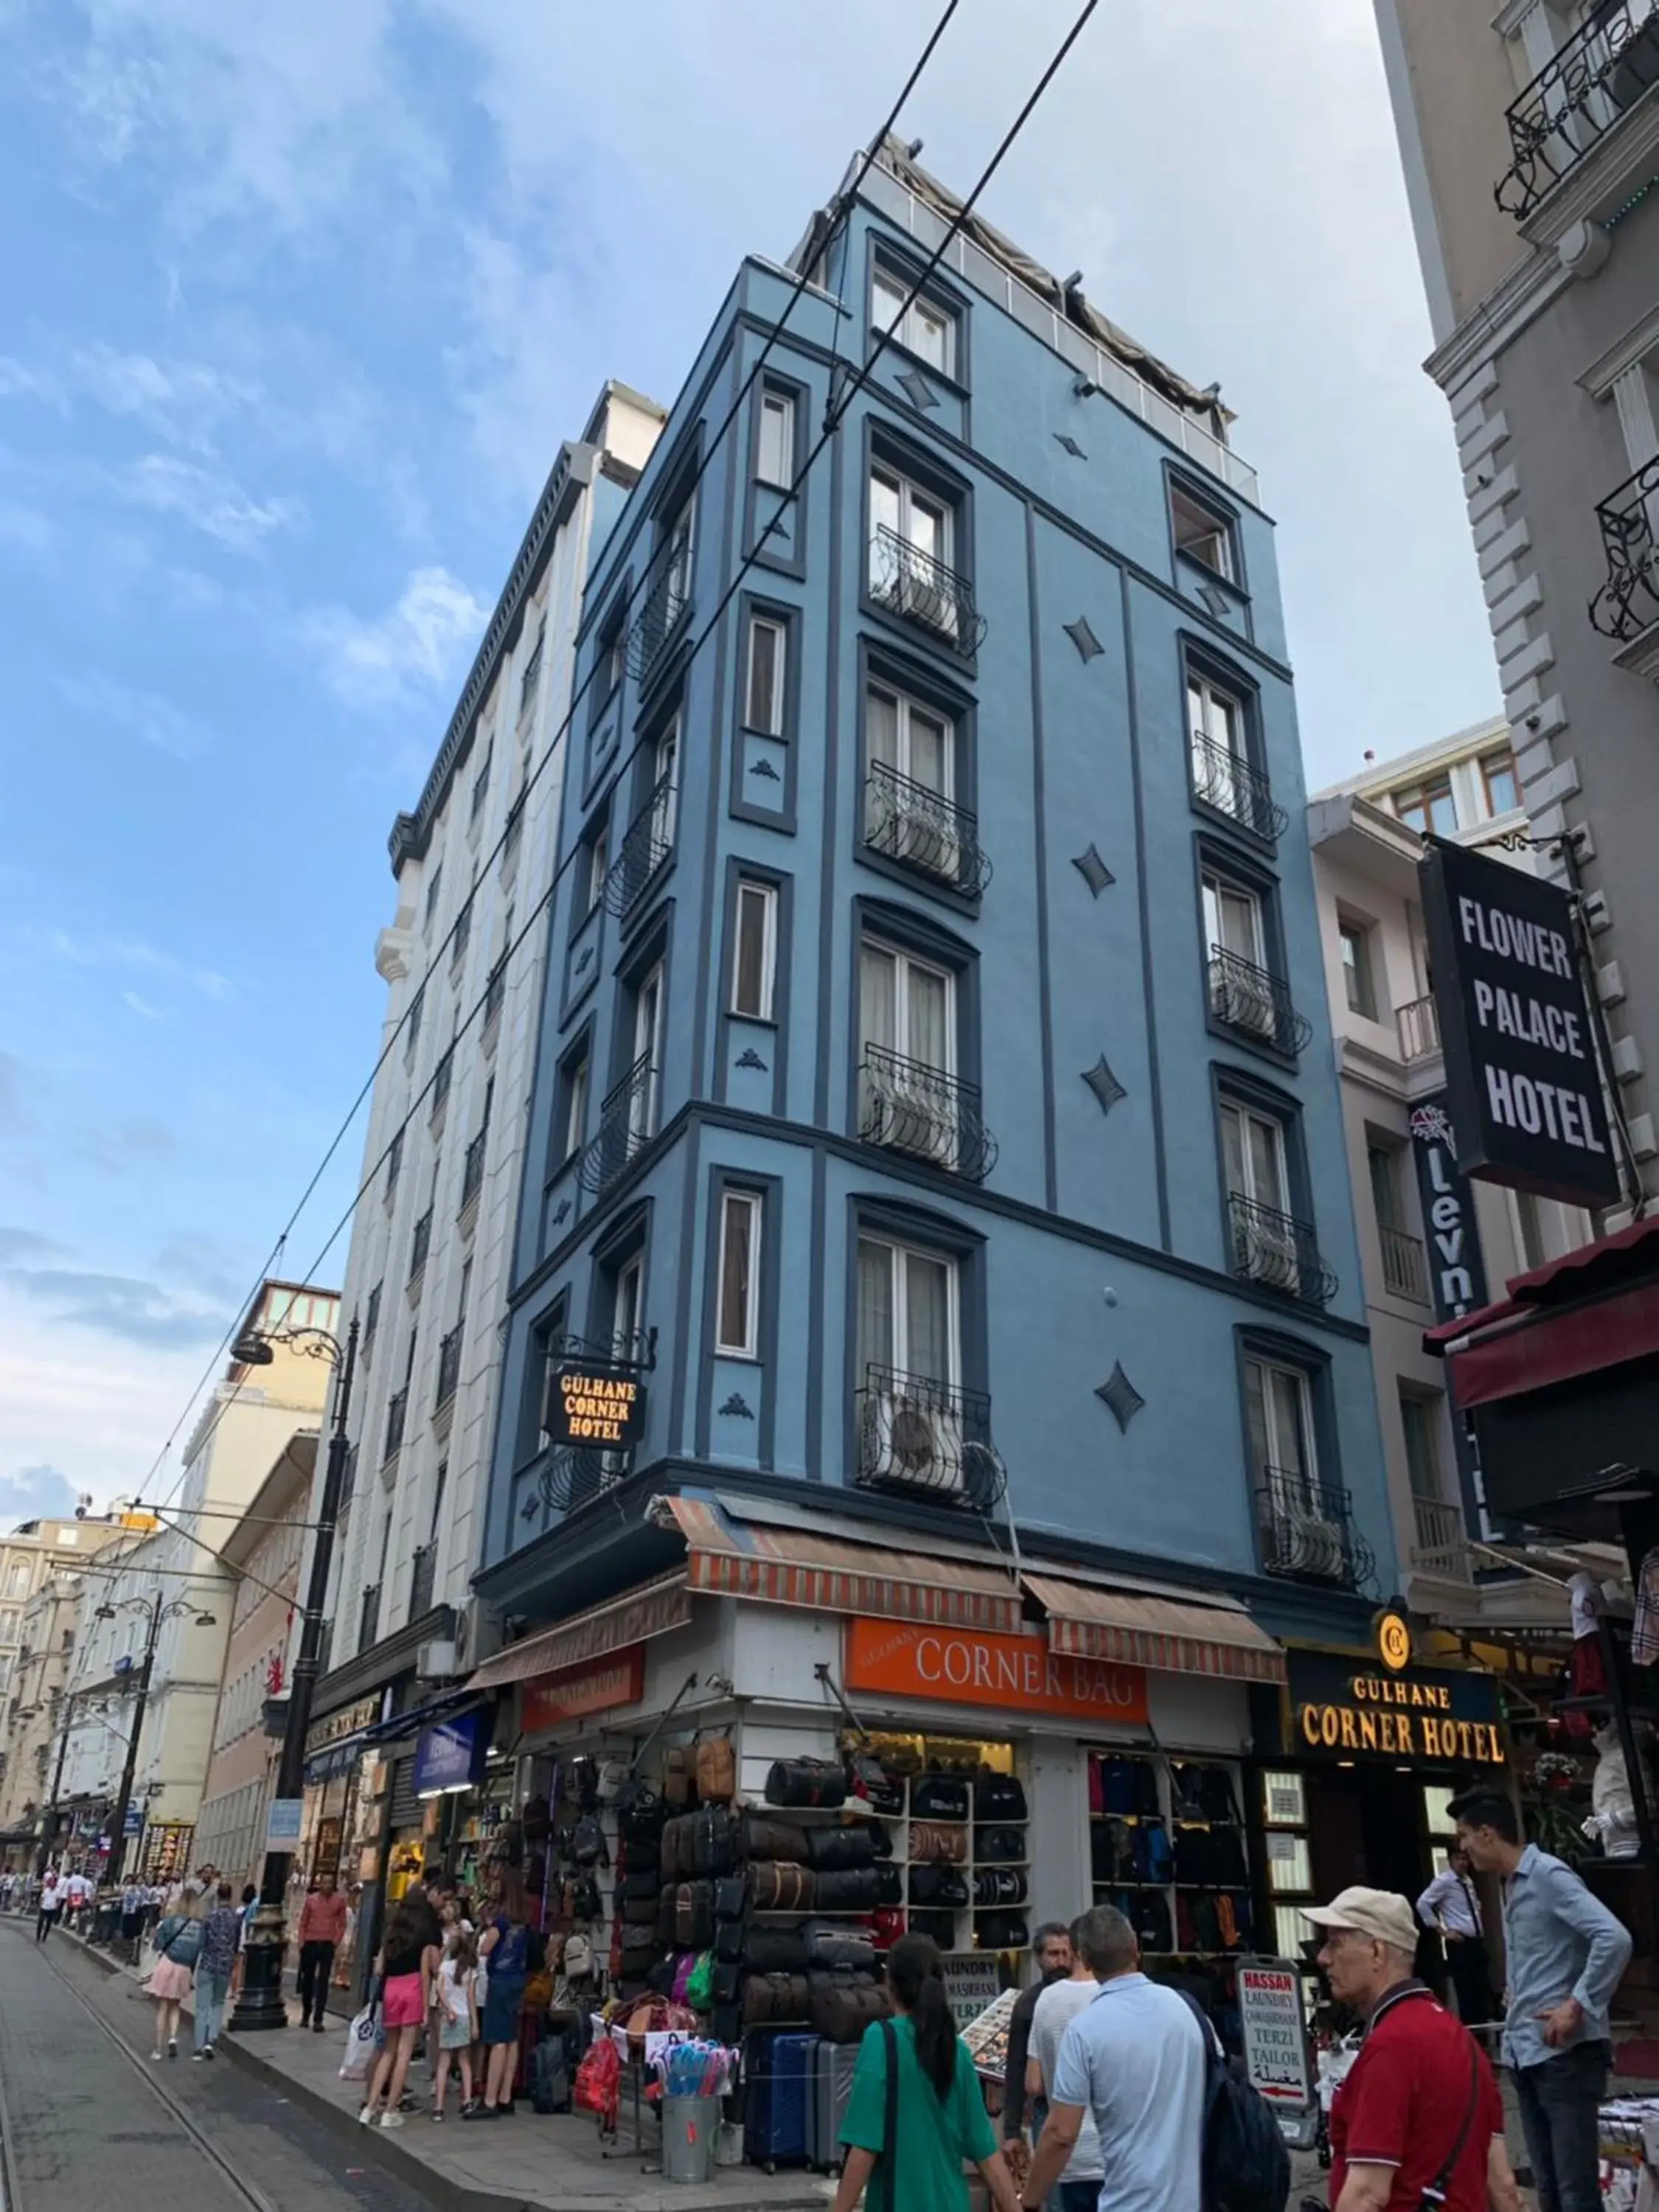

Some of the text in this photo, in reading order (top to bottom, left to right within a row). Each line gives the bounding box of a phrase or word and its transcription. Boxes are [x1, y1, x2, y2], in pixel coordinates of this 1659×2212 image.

[1458, 894, 1573, 980] FLOWER
[1474, 978, 1585, 1060] PALACE
[1484, 1064, 1605, 1154] HOTEL
[564, 1395, 629, 1422] CORNER
[568, 1416, 622, 1441] HOTEL
[917, 1637, 1133, 1706] CORNER BAG
[1303, 1704, 1504, 1763] CORNER HOTEL
[1243, 1970, 1292, 1992] HASSAN
[1244, 1991, 1293, 2010] LAUNDRY
[1251, 2048, 1301, 2067] TAILOR
